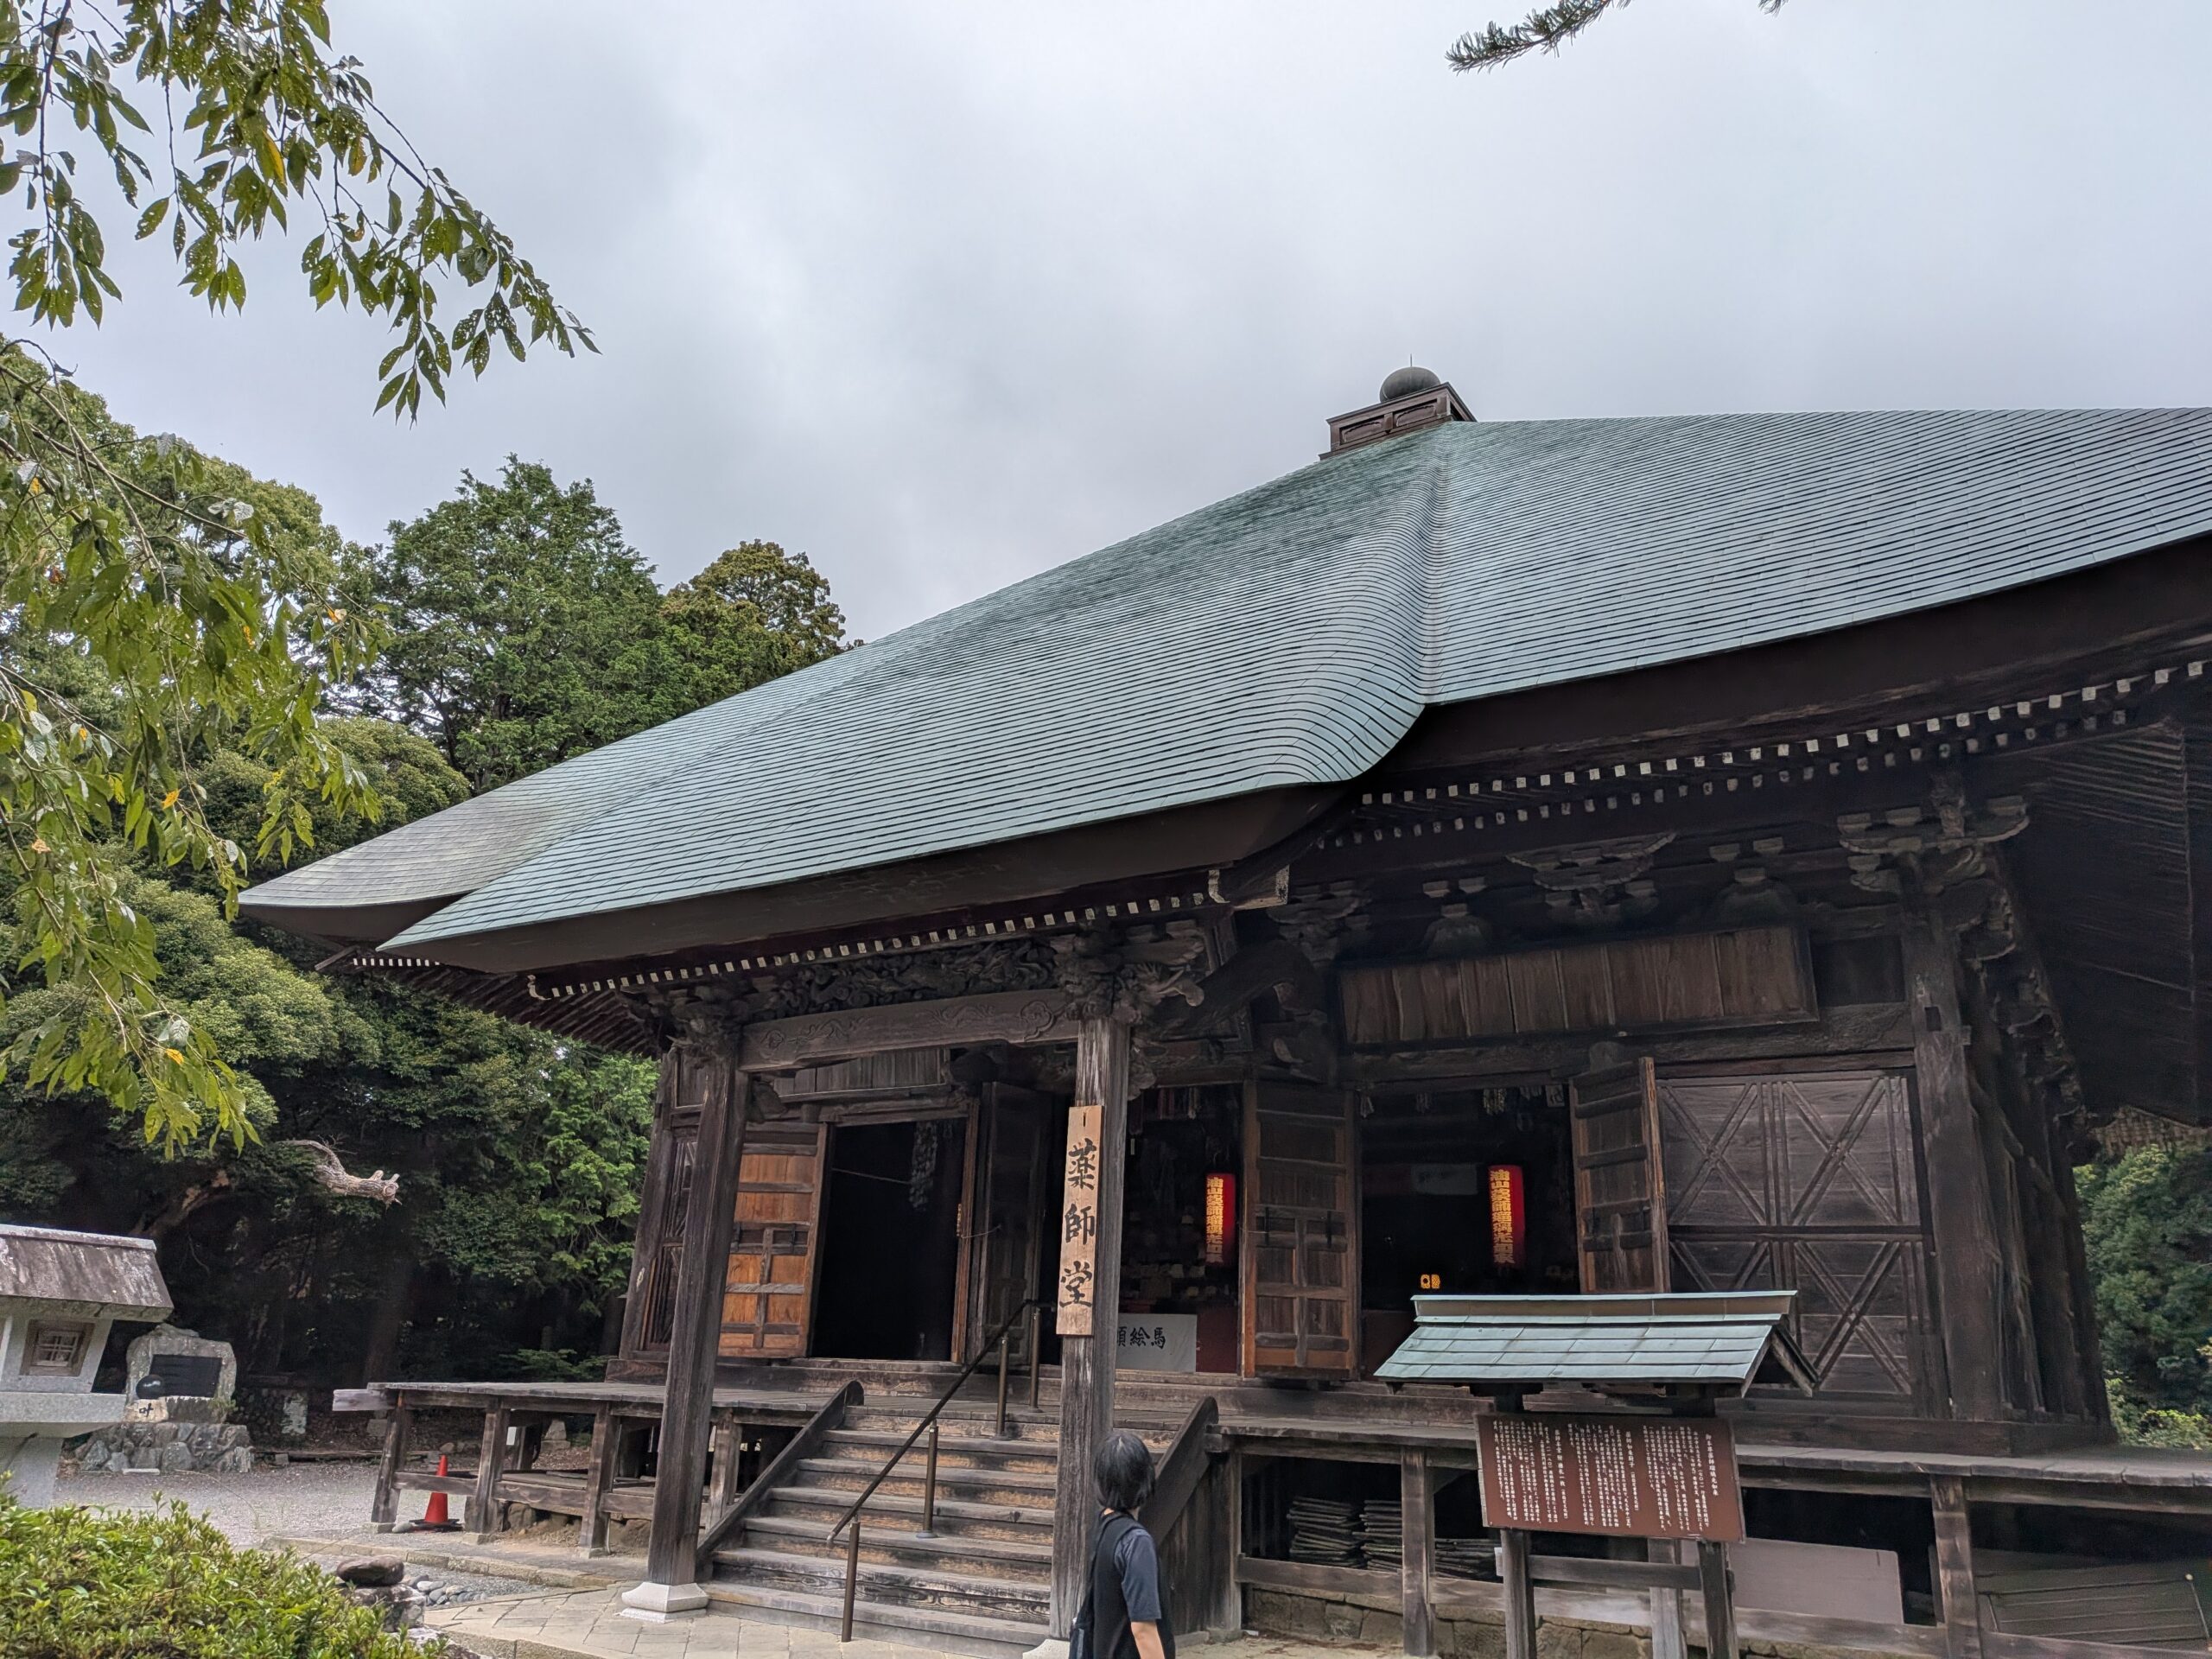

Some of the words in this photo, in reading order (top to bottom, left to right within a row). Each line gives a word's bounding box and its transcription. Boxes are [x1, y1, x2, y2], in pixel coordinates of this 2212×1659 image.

[1058, 1137, 1096, 1307] 薬師堂
[139, 1403, 154, 1417] 叶
